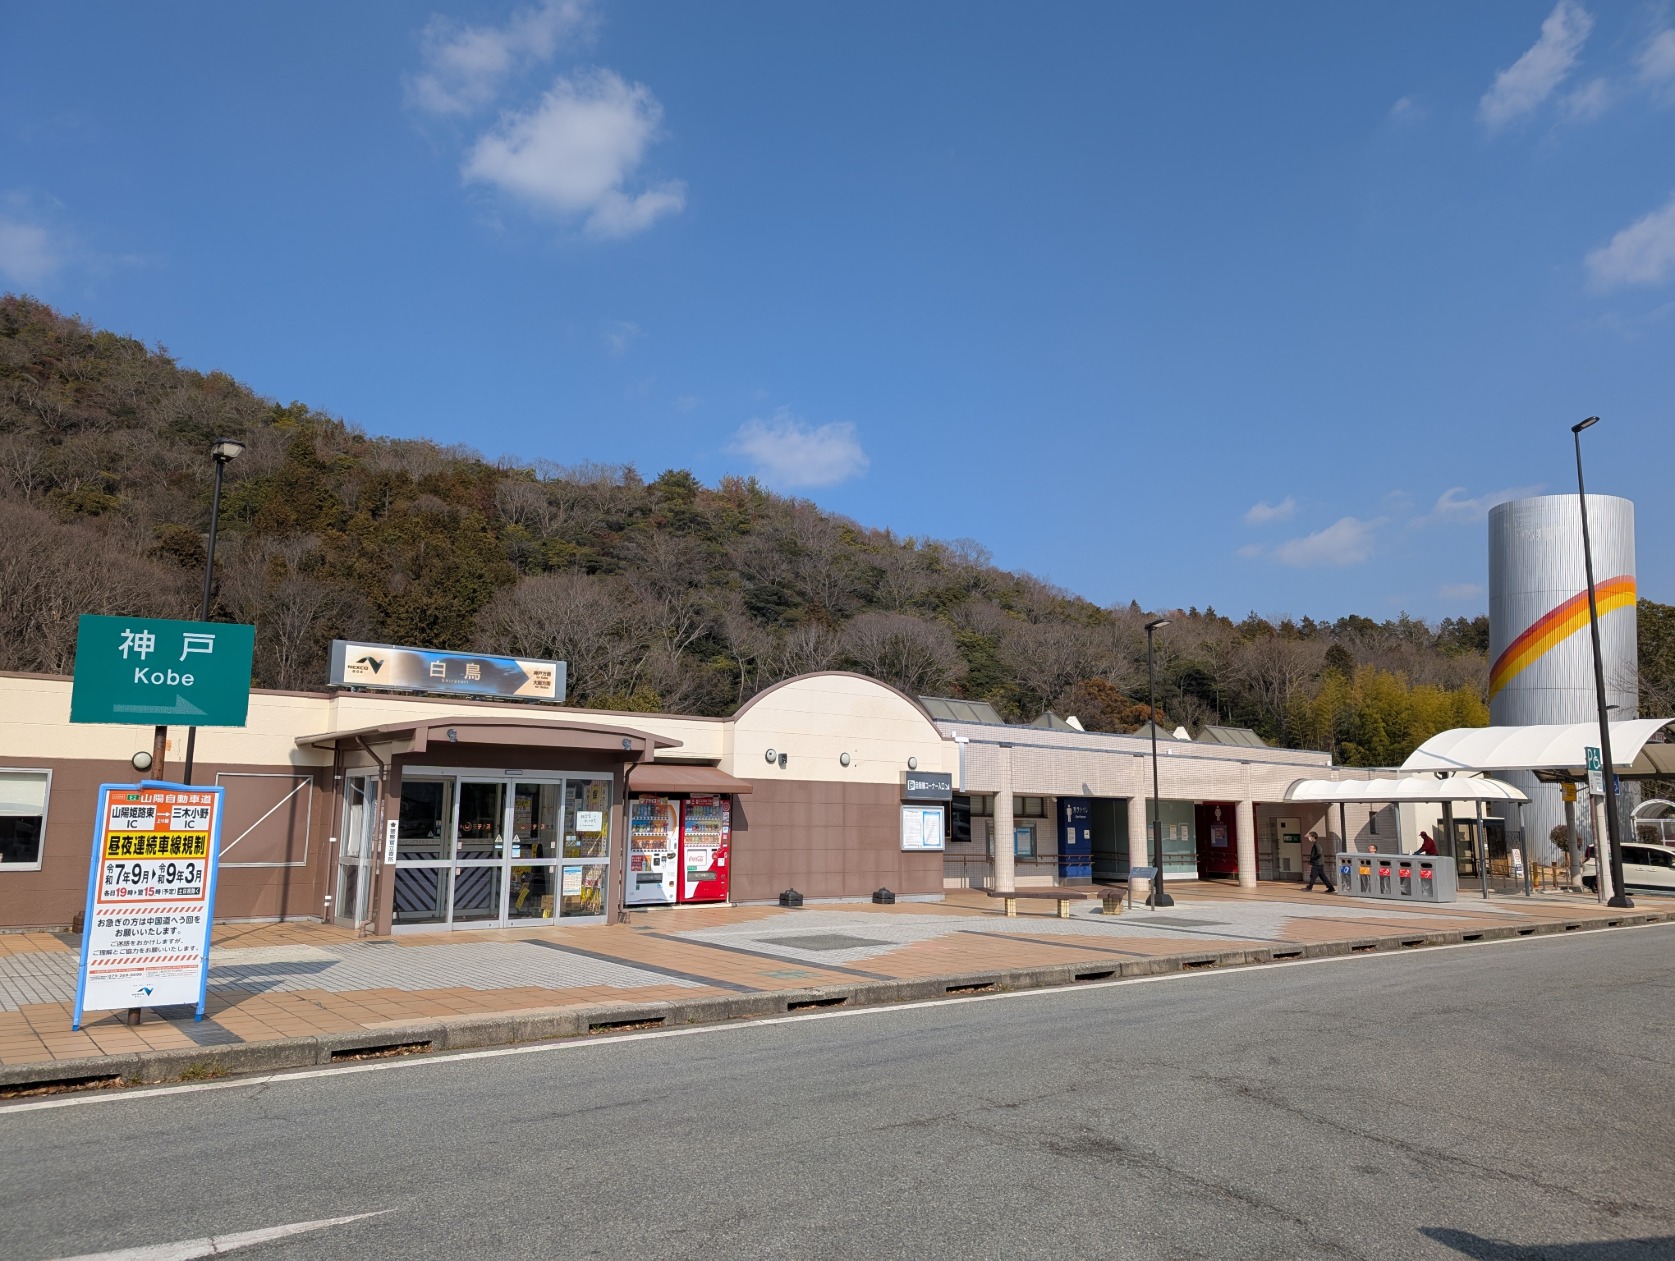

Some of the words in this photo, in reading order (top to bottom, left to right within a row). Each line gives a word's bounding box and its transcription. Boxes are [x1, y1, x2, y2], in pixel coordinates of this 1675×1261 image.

[118, 628, 216, 662] 神戸
[429, 660, 482, 680] 白鳥
[134, 667, 195, 687] Kobe
[1587, 748, 1593, 769] P
[140, 793, 212, 804] 山陽自動車道
[111, 806, 155, 819] 山陽姫路東
[172, 807, 209, 819] 三木小野
[126, 819, 138, 829] IC
[184, 820, 195, 829] IC
[107, 835, 206, 856] 昼夜連続車線規制
[97, 915, 201, 928] お急ぎの方は中国道へう回を
[114, 926, 182, 938] お願いいたします。
[92, 945, 200, 956] ご理解とご協力をお願いいたします。
